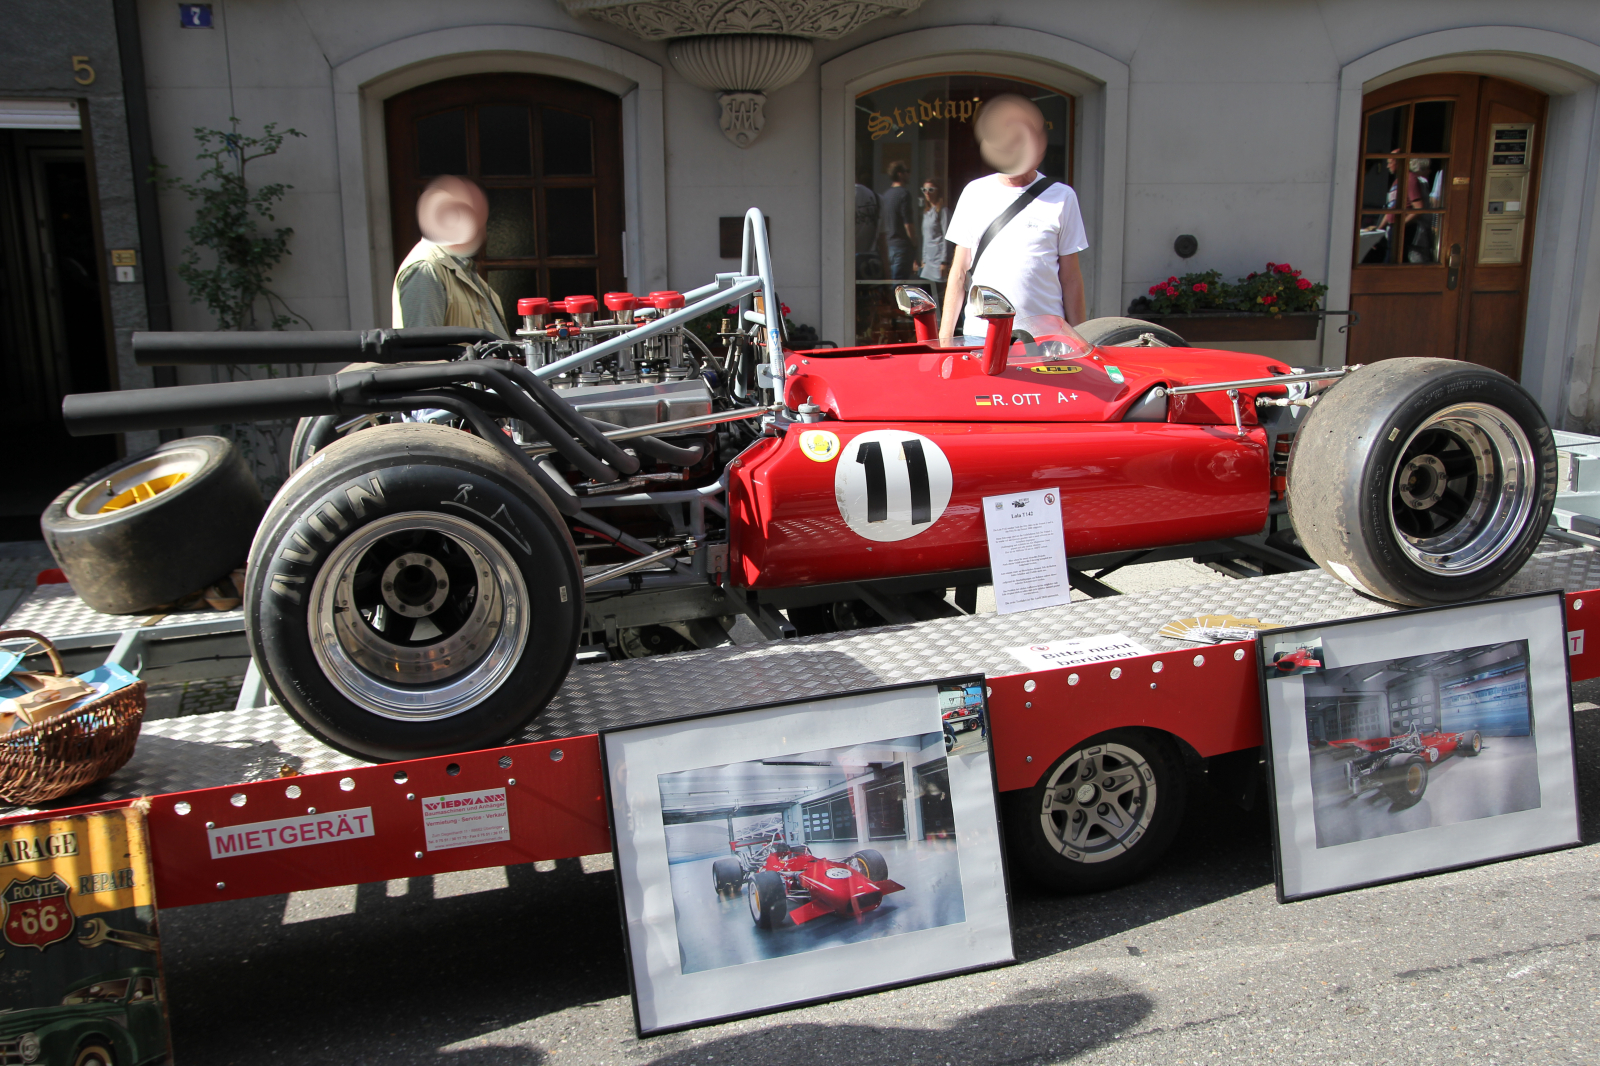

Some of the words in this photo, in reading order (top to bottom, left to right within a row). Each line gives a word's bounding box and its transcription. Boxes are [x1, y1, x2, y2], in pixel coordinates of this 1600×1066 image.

[190, 7, 201, 25] 7
[72, 56, 96, 85] 5
[992, 394, 1009, 406] R.
[1011, 393, 1041, 405] OTT
[856, 439, 931, 525] 11
[270, 477, 386, 605] AVON
[1041, 648, 1085, 660] Bitte
[1088, 642, 1134, 653] nicht
[1057, 651, 1140, 666] berühren
[425, 807, 466, 817] Baumaschinen
[479, 801, 506, 811] Anhänger
[426, 818, 458, 827] Vermietung
[461, 815, 482, 823] Service
[485, 811, 507, 819] Verkauf
[215, 814, 368, 854] MIETGERÄT
[13, 881, 60, 900] ROUTE
[79, 868, 135, 896] REPAIR
[21, 905, 59, 935] 66
